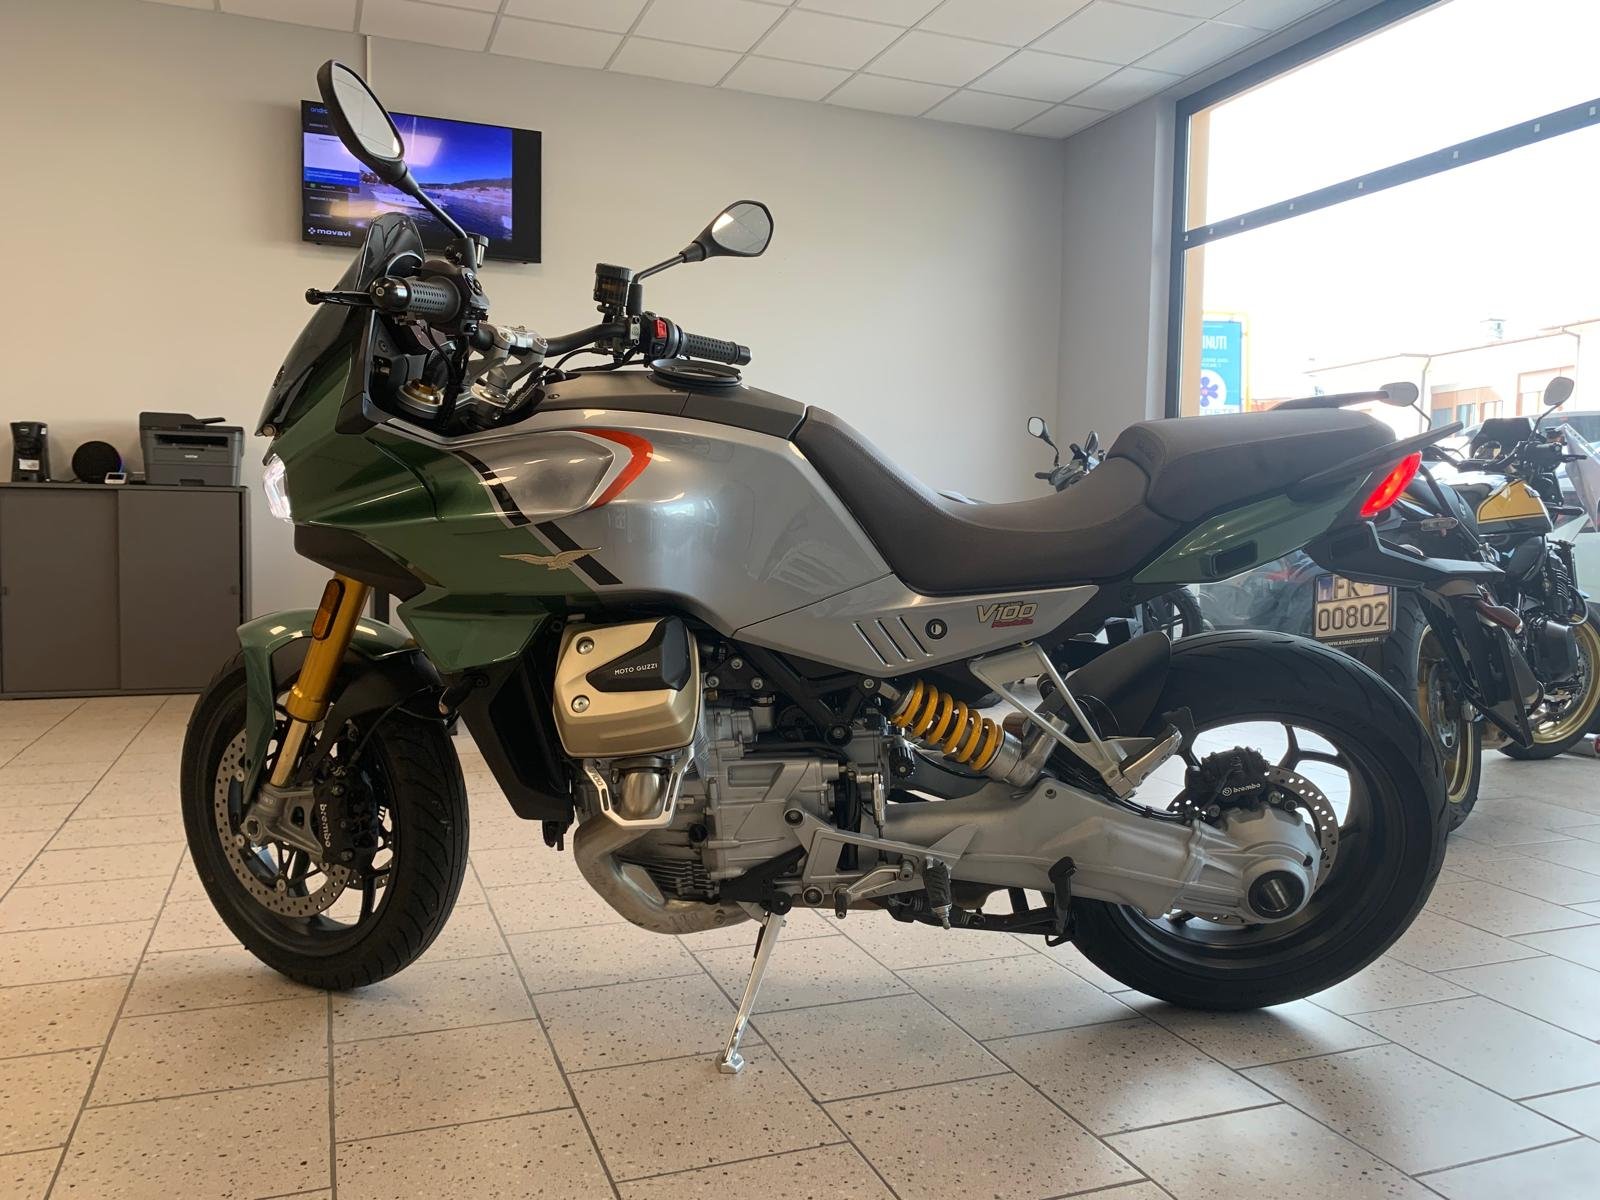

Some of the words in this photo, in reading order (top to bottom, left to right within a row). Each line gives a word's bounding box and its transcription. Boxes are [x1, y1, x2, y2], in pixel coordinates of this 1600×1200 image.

[317, 229, 351, 237] movavi
[976, 602, 1038, 623] V100
[1318, 601, 1388, 631] 00802
[614, 666, 635, 676] MOTO
[636, 662, 658, 672] GUZZI
[1233, 783, 1261, 793] brembo
[319, 803, 332, 848] brembo
